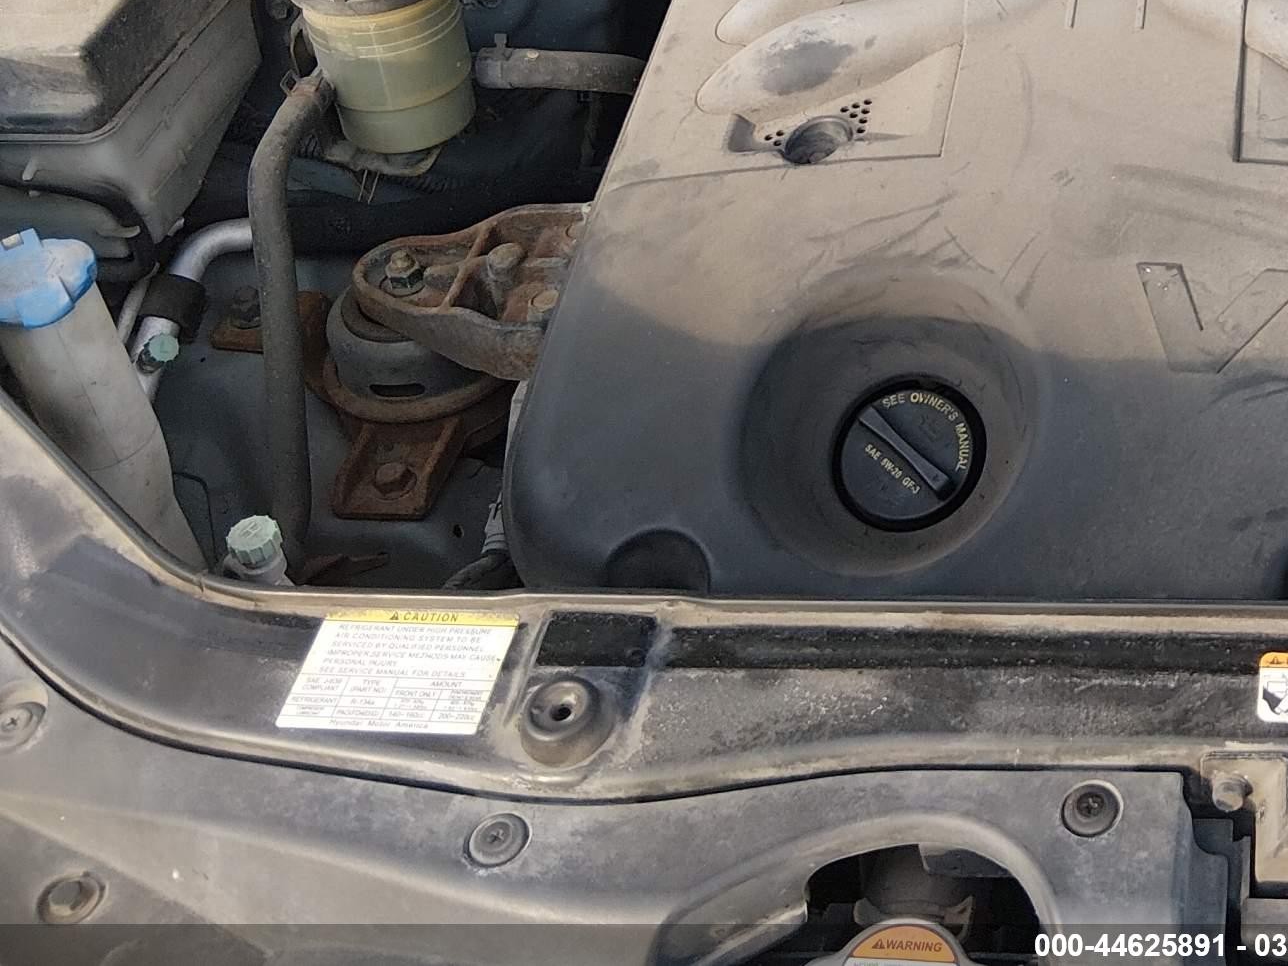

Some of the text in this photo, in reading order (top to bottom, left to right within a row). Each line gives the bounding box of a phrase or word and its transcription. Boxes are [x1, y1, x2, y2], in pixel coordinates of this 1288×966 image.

[882, 392, 972, 472] SEE OWNER'S MANUAL
[864, 444, 881, 462] SAE
[402, 612, 458, 623] CAUTION
[338, 624, 394, 632] REFRIGERANT
[352, 633, 415, 641] CONDITIONING
[886, 939, 943, 953] WARNING
